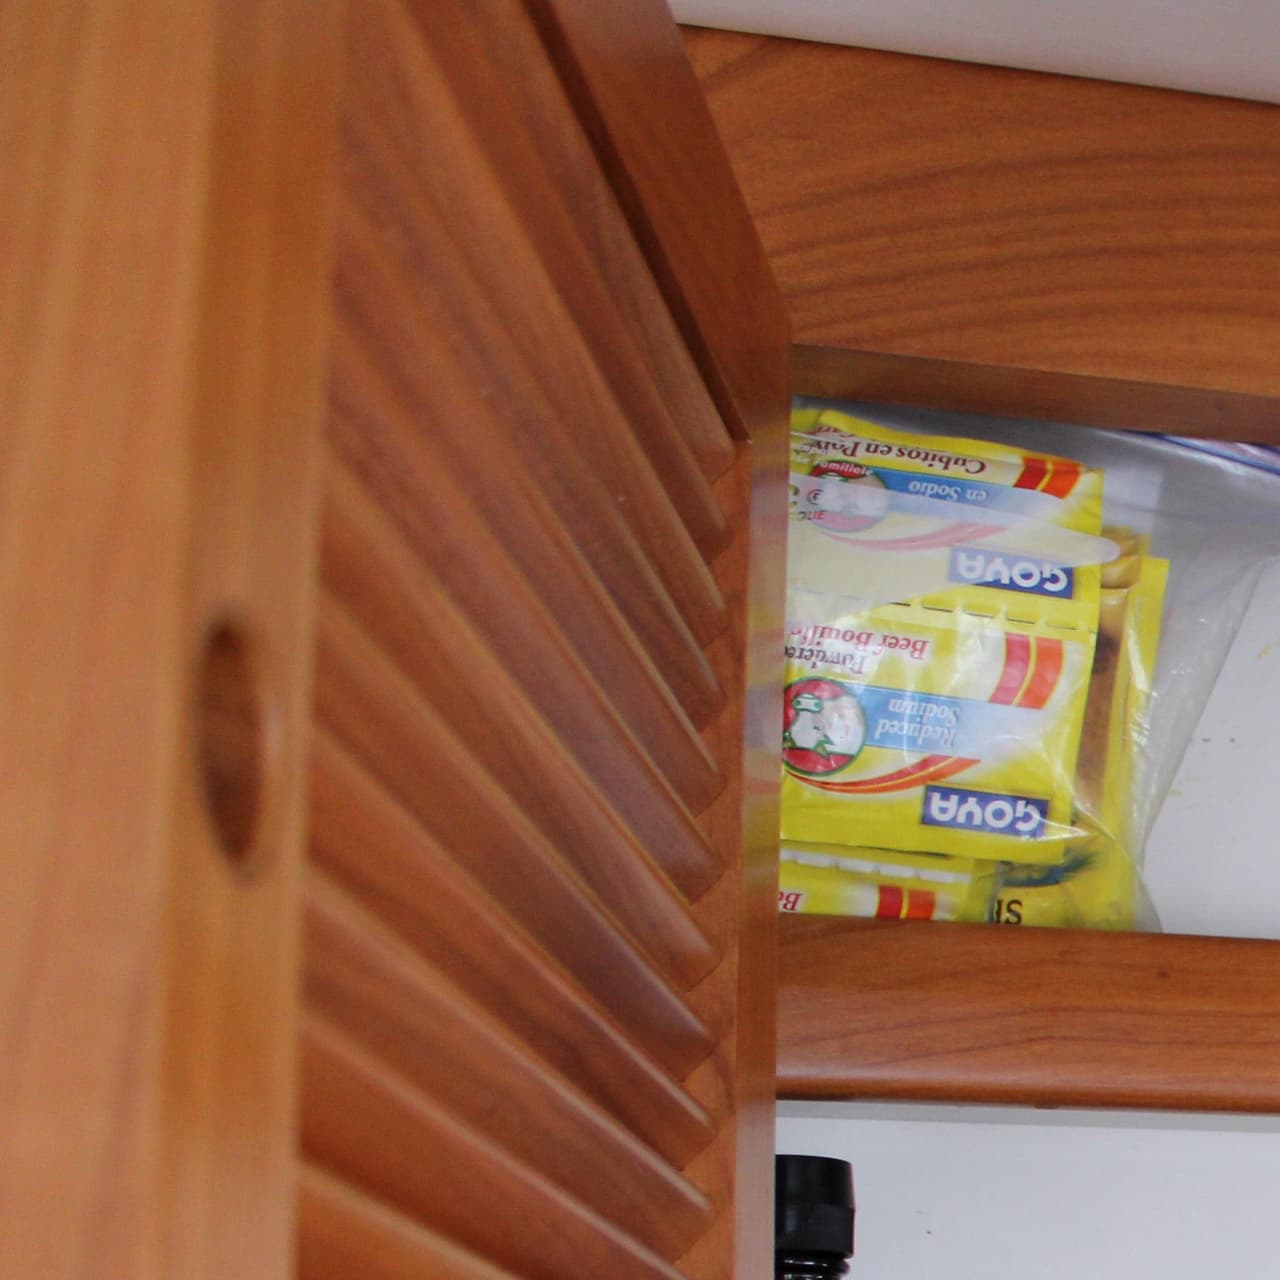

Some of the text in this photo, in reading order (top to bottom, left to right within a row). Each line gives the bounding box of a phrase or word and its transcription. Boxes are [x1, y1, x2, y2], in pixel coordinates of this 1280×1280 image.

[864, 440, 987, 475] Cubitos en
[908, 480, 987, 502] en Sodio
[957, 551, 1069, 593] GOYA
[877, 632, 930, 661] Beef
[888, 698, 961, 727] Sodium
[874, 717, 958, 748] Reduced
[929, 791, 1042, 833] GOYA
